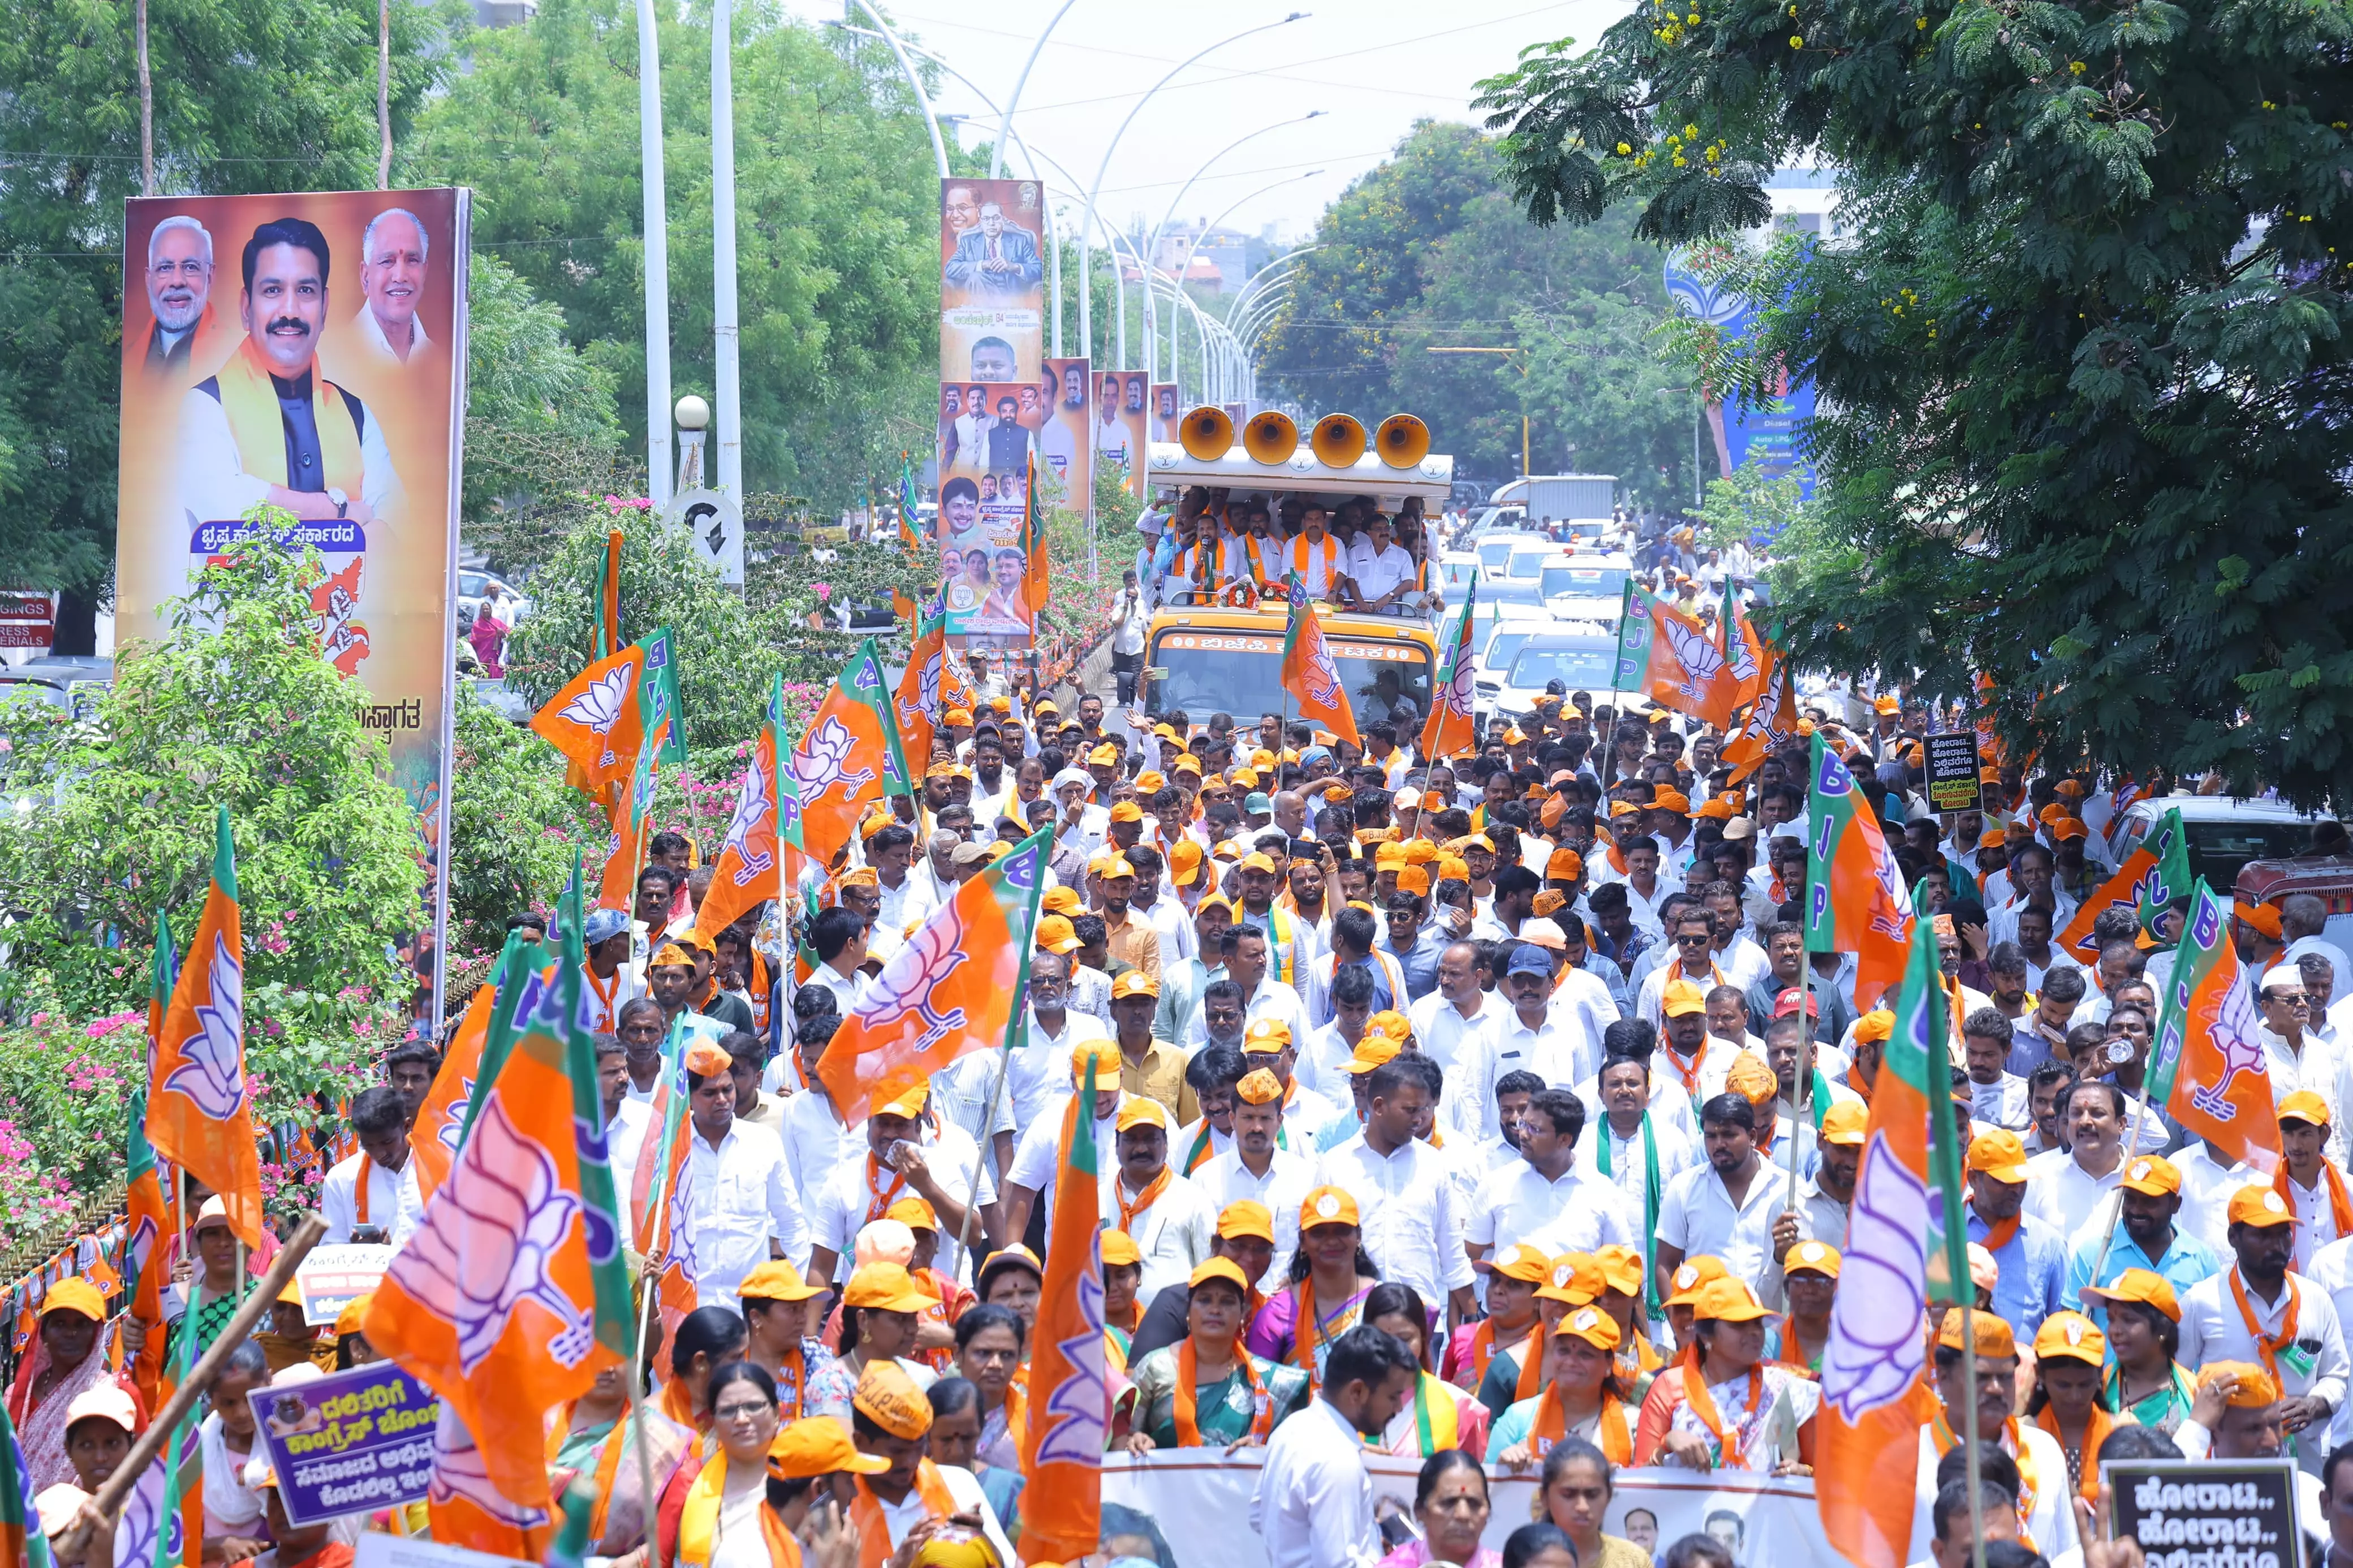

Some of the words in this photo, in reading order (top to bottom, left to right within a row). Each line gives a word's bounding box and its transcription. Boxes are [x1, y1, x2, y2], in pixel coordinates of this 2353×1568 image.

[1200, 638, 1268, 651] ಬಿಜೆಪಿ
[1622, 594, 1649, 680] BJP
[1933, 783, 1955, 791] ಕಾಂಗ್ರೆಸ್
[1936, 766, 1971, 776] ಹೋರಾಟ
[1942, 798, 1969, 807] ಹೋರಾಟ
[1812, 746, 1854, 931] BJP
[2157, 888, 2221, 1072] BJP
[320, 1379, 407, 1420] ದಲಿತರಿಗೆ
[285, 1415, 373, 1454] ಕಾಂಗ್ರೆಸ್
[294, 1452, 378, 1488] ಸಮಾಜದ
